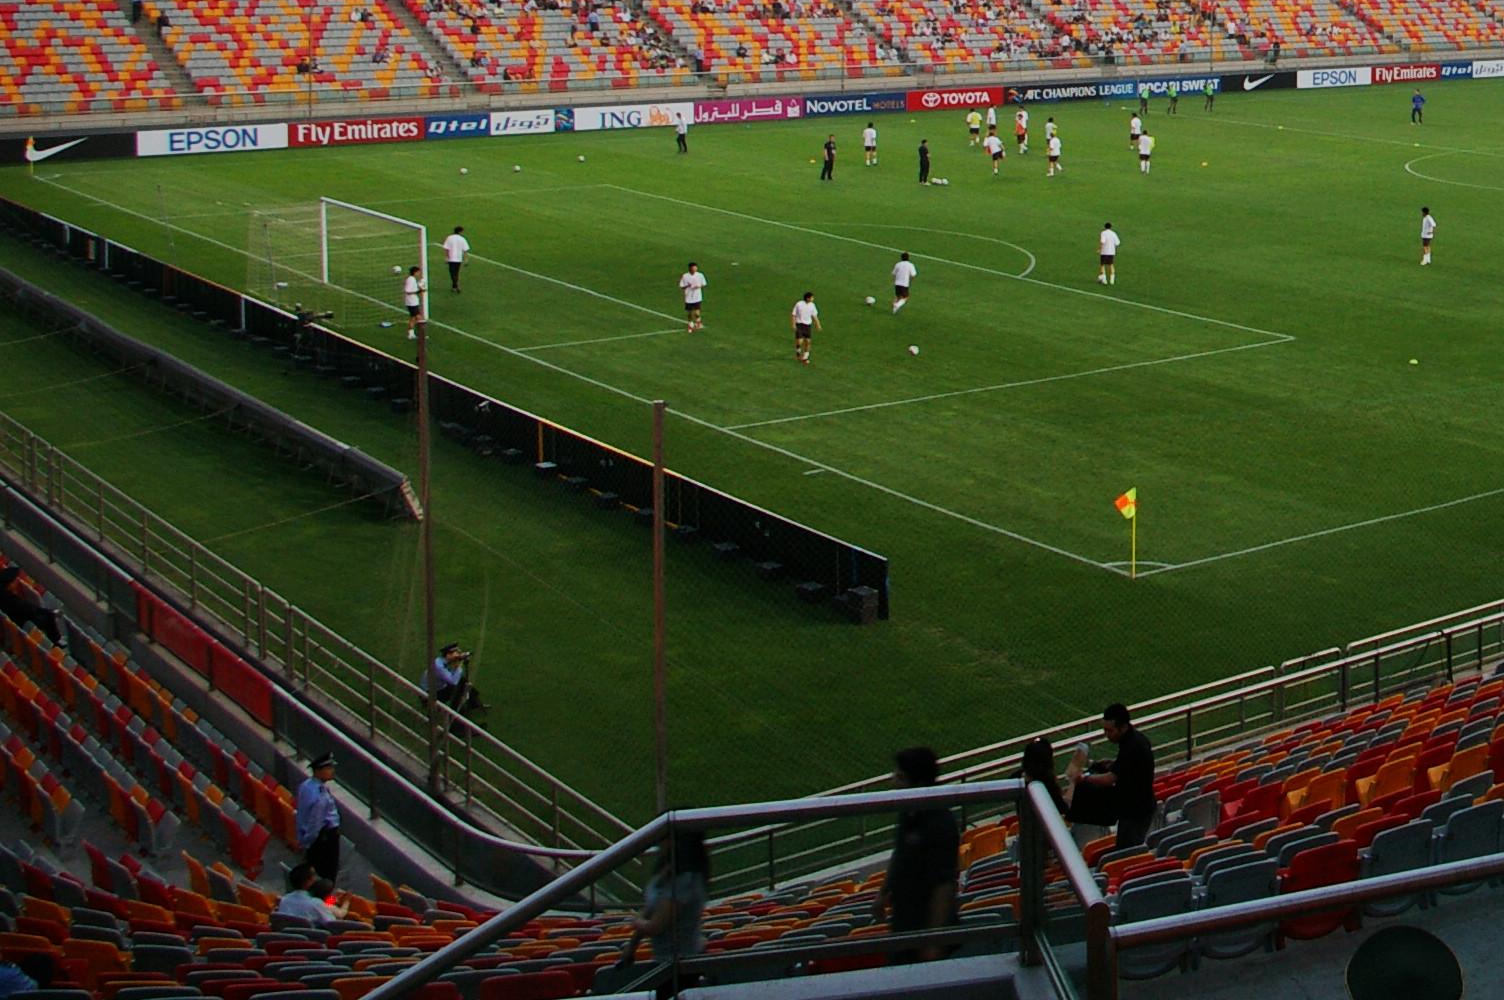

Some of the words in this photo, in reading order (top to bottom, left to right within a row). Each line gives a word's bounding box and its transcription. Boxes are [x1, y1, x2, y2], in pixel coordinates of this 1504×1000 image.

[1312, 70, 1357, 86] EPSON
[1376, 67, 1393, 83] Fly
[1393, 65, 1437, 81] Emirates
[942, 91, 990, 105] TOYOTA
[1043, 86, 1097, 100] CHAMPIONS
[1099, 83, 1134, 96] LEAGUE
[740, 100, 783, 119] قطر
[806, 98, 871, 114] NOVOTEL
[428, 118, 488, 134] Qtel
[600, 110, 642, 128] ING
[169, 127, 259, 152] EPSON
[297, 122, 331, 145] Fly
[334, 119, 418, 140] Emirates
